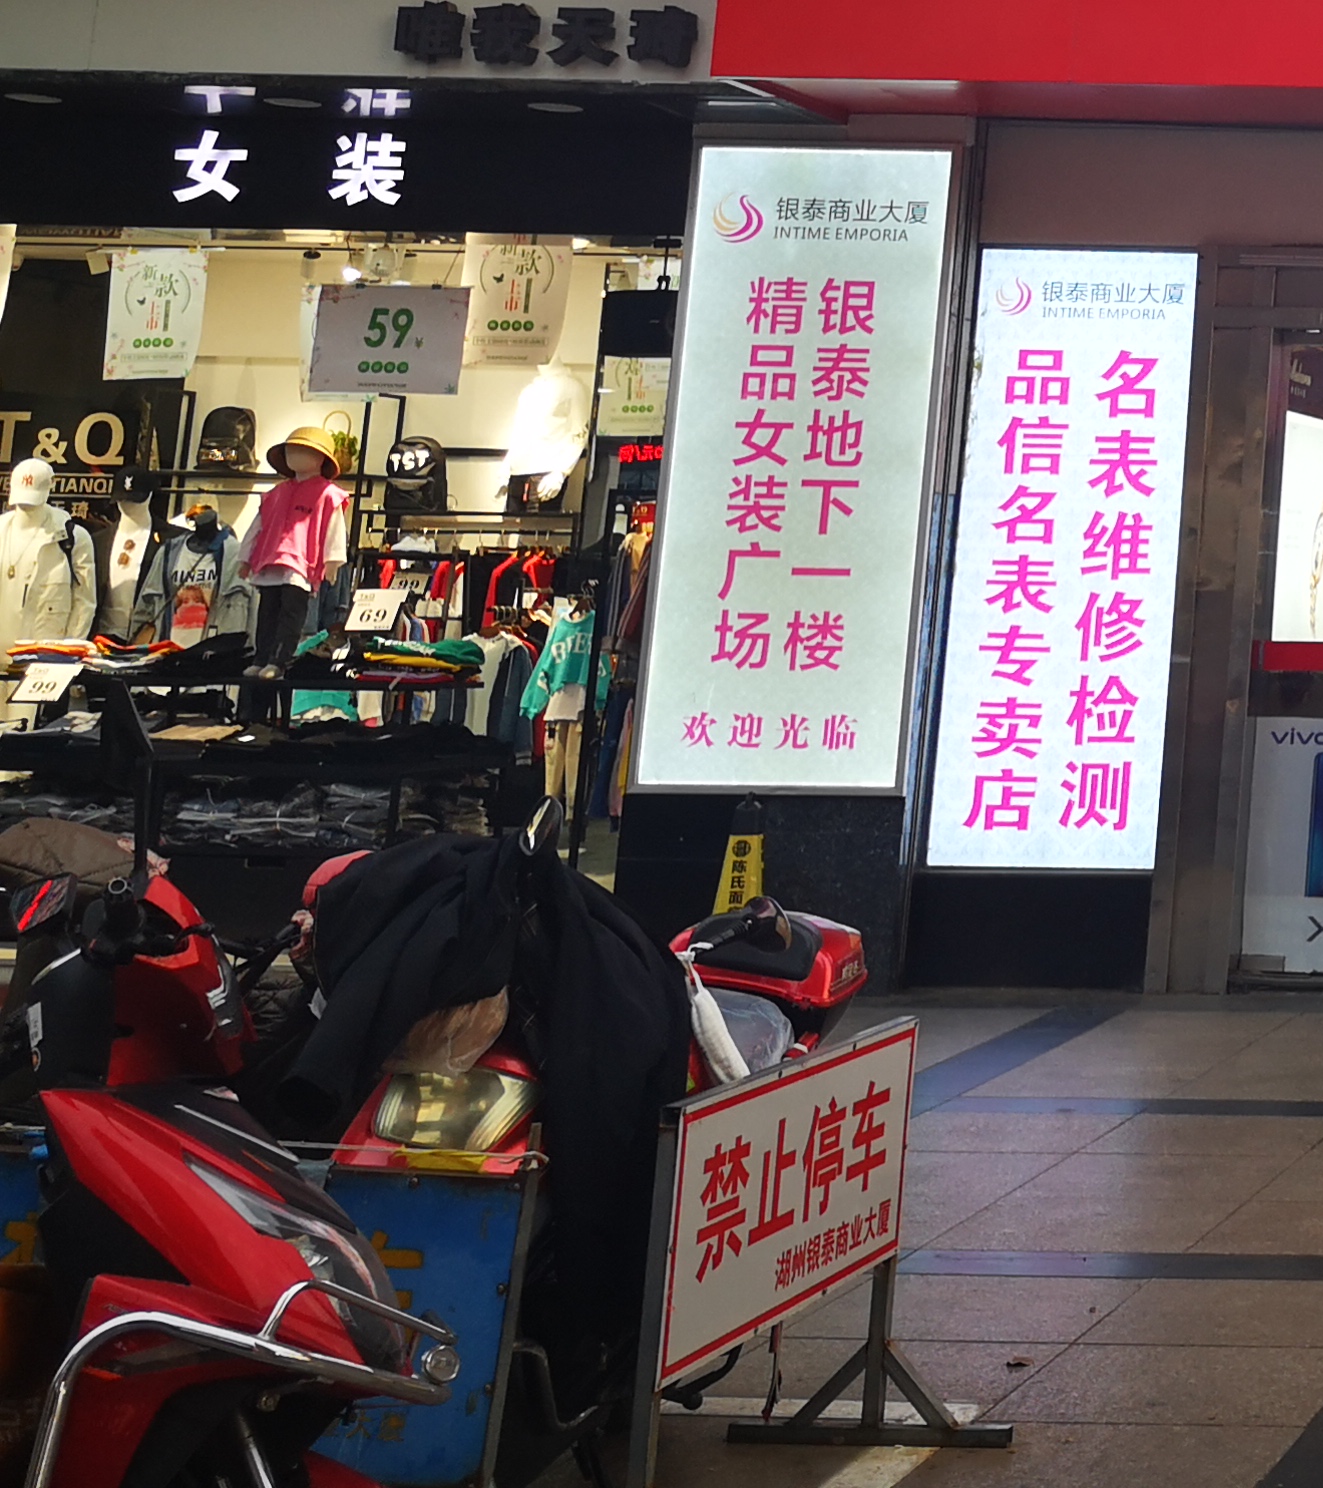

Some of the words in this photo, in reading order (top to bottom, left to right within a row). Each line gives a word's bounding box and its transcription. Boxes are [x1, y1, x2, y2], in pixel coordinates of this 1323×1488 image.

[173, 129, 406, 206] 女装
[774, 227, 830, 242] INTIME
[835, 229, 909, 243] EMPORIA
[776, 196, 930, 226] 银泰商业大厦
[1042, 279, 1186, 307] 银泰商业大厦
[1042, 307, 1094, 320] INTIME
[1098, 308, 1167, 321] EMPORIA
[711, 276, 808, 671] 精品女装广场
[783, 277, 876, 672] 银泰地下一楼
[359, 608, 387, 624] 69
[963, 349, 1071, 831] 品信名表专卖店
[1058, 349, 1159, 832] 名表维修检测
[681, 712, 858, 751] 欢迎光临
[726, 860, 751, 913] 陈氏面
[695, 1079, 892, 1282] 禁止停车
[773, 1198, 893, 1293] 湖州银泰商业大厦
